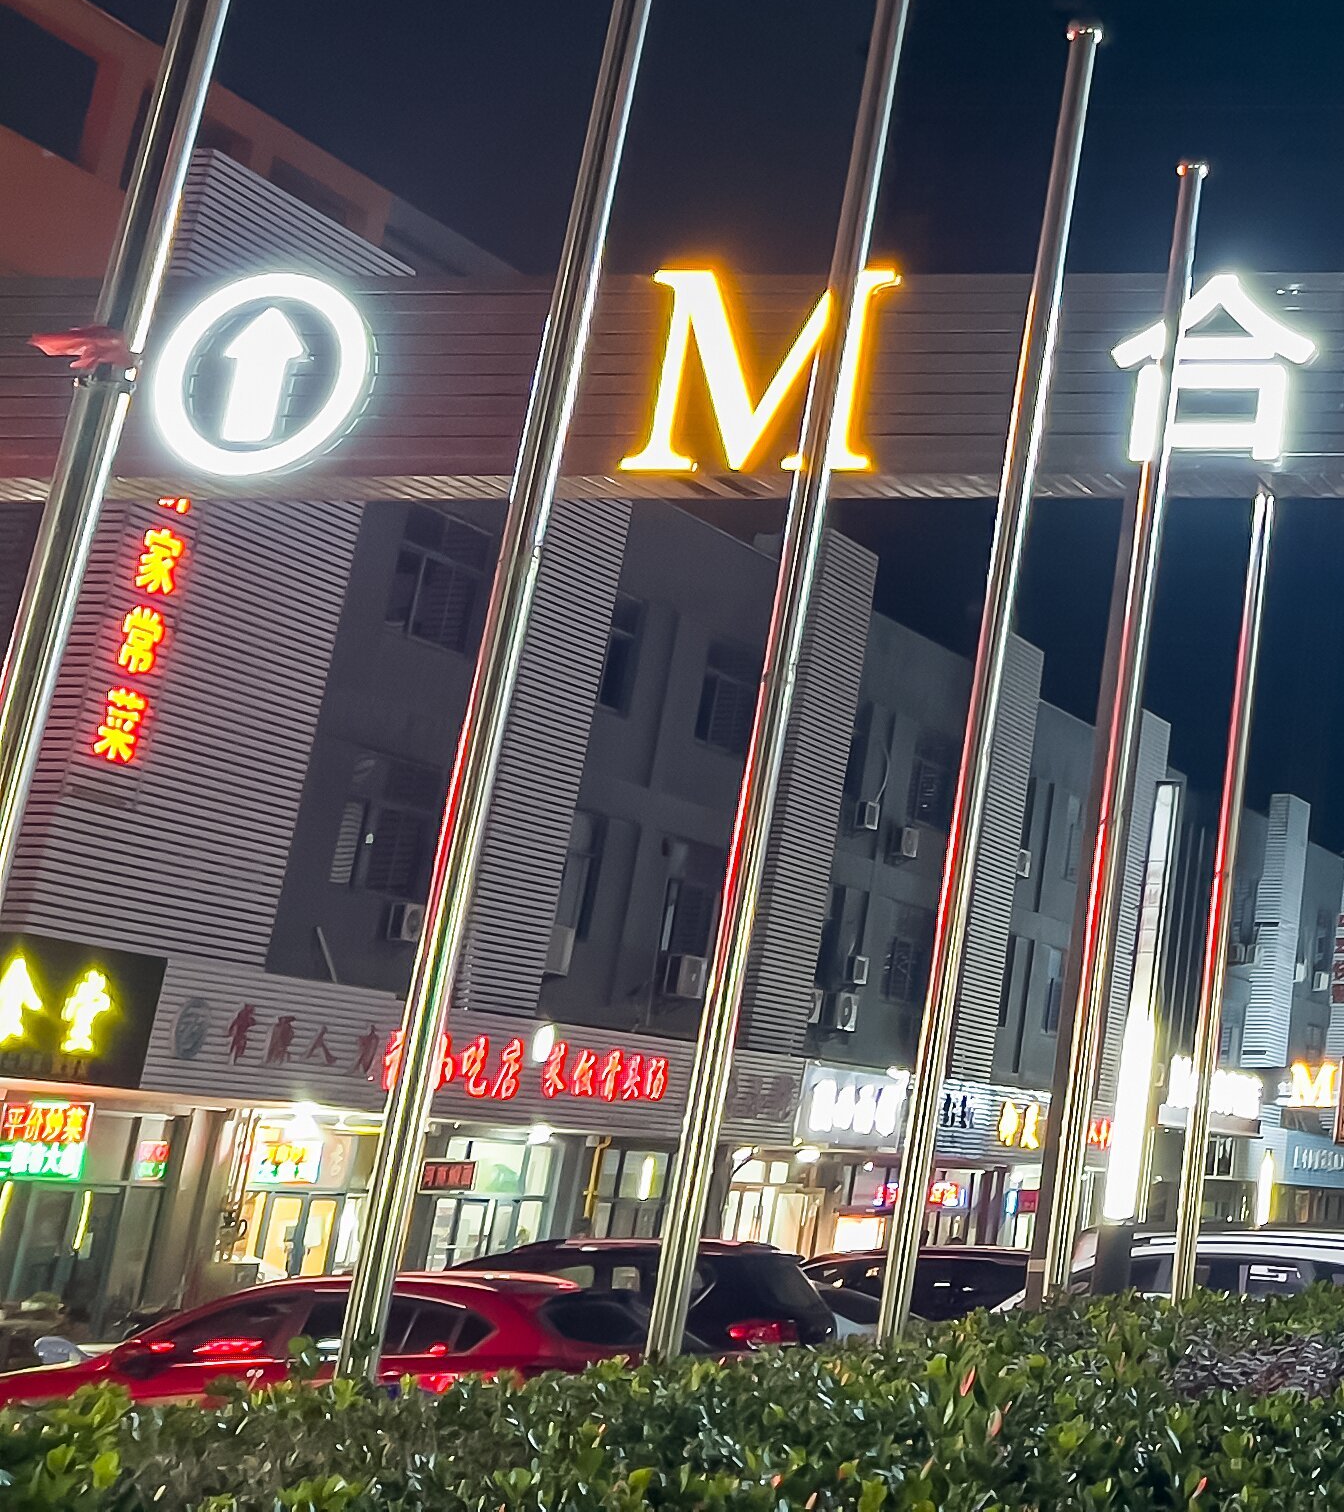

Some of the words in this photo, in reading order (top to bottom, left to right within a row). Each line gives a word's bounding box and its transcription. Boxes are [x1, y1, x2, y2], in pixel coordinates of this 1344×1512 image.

[620, 266, 903, 474] M
[92, 497, 191, 764] 家常菜
